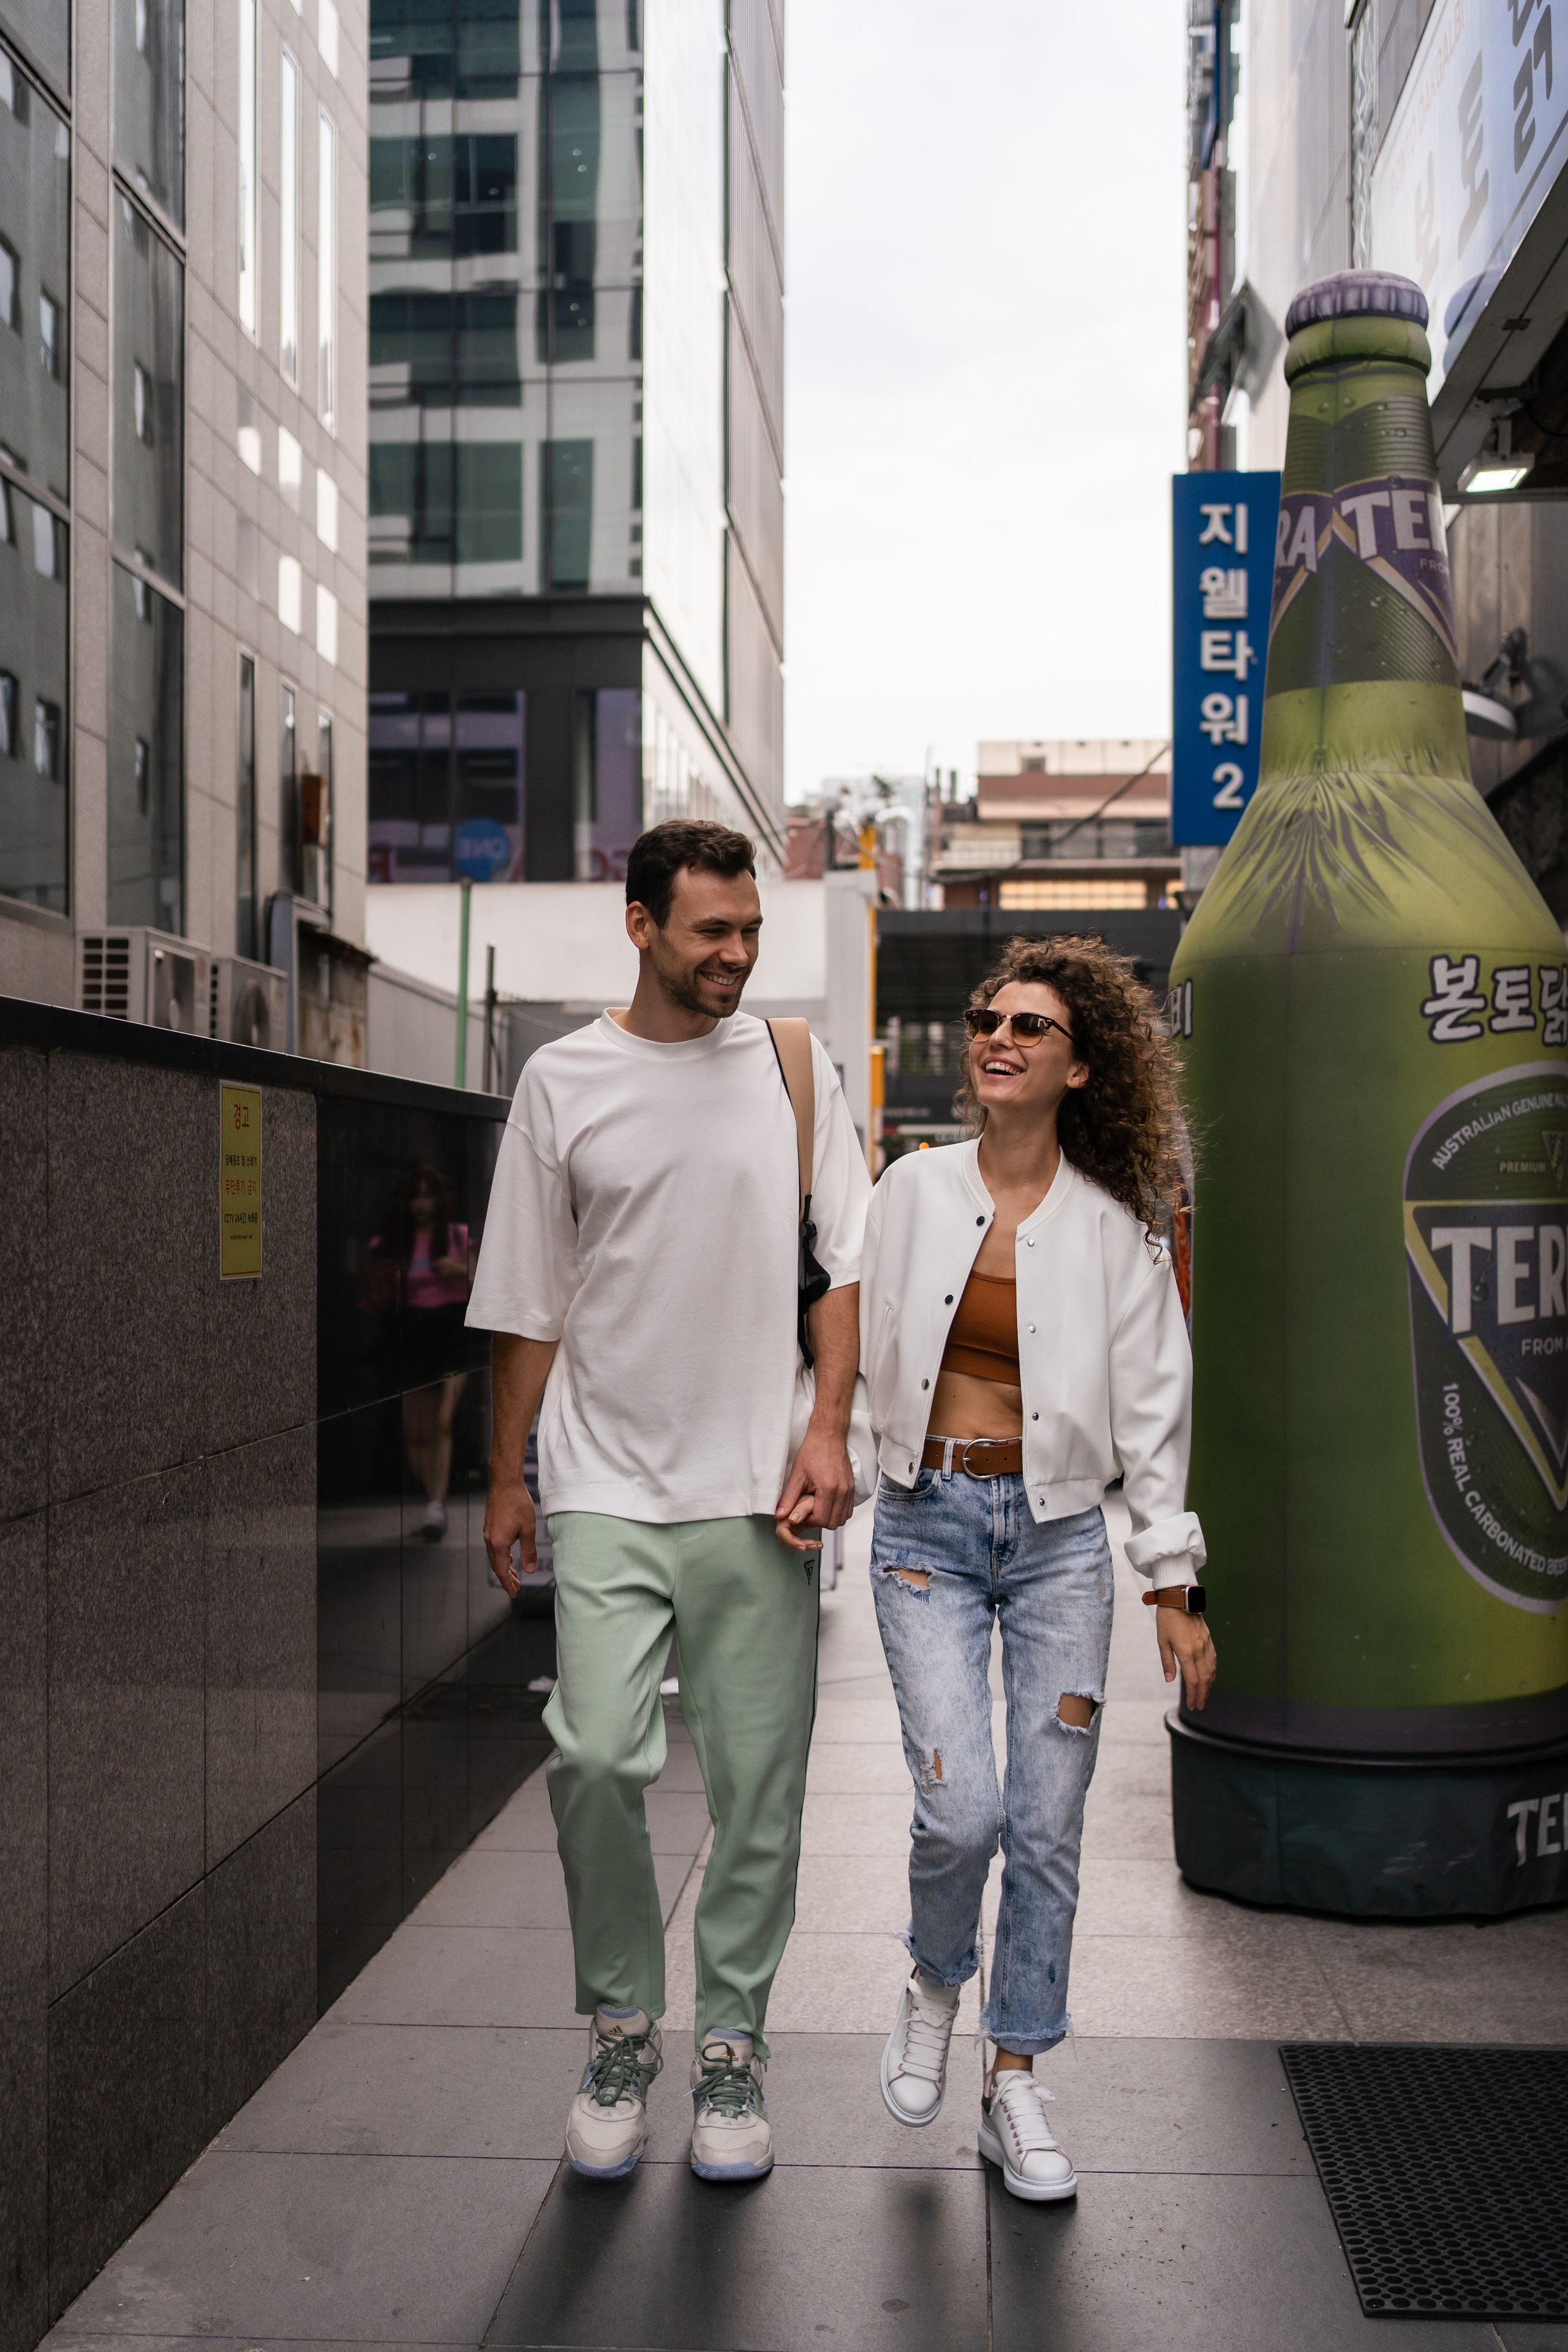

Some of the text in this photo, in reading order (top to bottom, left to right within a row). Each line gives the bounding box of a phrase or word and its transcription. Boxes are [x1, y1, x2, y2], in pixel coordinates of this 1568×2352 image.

[1419, 558, 1449, 575] FRO
[1199, 503, 1252, 809] 지웰타워 2
[233, 1103, 250, 1130] 경고
[1431, 1104, 1512, 1170] AUSTRALIAN
[1500, 1160, 1546, 1173] PREMIUM
[225, 1178, 257, 1196] 무단투기 금지
[224, 1213, 235, 1223] CCTV
[235, 1212, 247, 1224] 24시간
[1431, 1224, 1568, 1335] TER
[1521, 1336, 1564, 1356] FROM
[1443, 1382, 1464, 1436] 100%
[1447, 1437, 1472, 1493] REAL
[1464, 1490, 1546, 1574] CARBONATED
